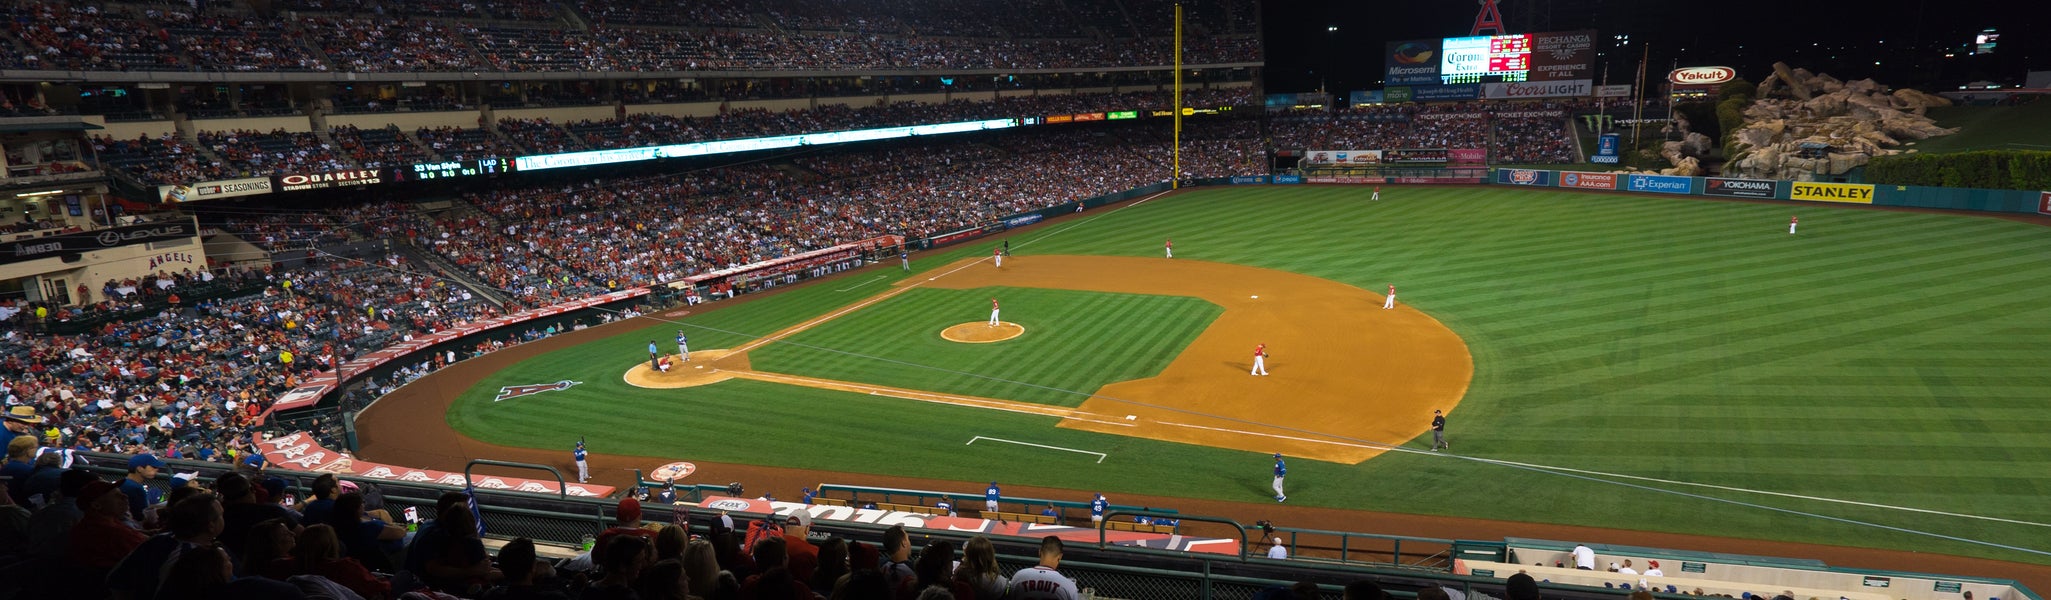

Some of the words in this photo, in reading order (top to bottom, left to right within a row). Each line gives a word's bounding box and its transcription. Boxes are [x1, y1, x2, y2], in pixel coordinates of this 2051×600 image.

[1538, 34, 1590, 44] PECHANGA
[1448, 52, 1485, 64] Corona
[1388, 65, 1436, 75] Microsemi
[1680, 71, 1724, 80] Yakult
[1506, 83, 1546, 96] Coors
[1548, 84, 1584, 94] LIGHT
[524, 157, 541, 168] The
[544, 156, 581, 166] Corona
[310, 170, 378, 183] OAKLEY
[224, 181, 269, 193] SEASONINGS
[1648, 180, 1685, 190] Experian
[1724, 180, 1770, 190] YOKOHAMA
[1793, 185, 1872, 200] STANLEY
[120, 225, 184, 240] LEXUS
[15, 242, 62, 256] AM830
[148, 252, 193, 270] ANGELS
[718, 501, 740, 509] FOX
[1022, 580, 1060, 594] TROUT
